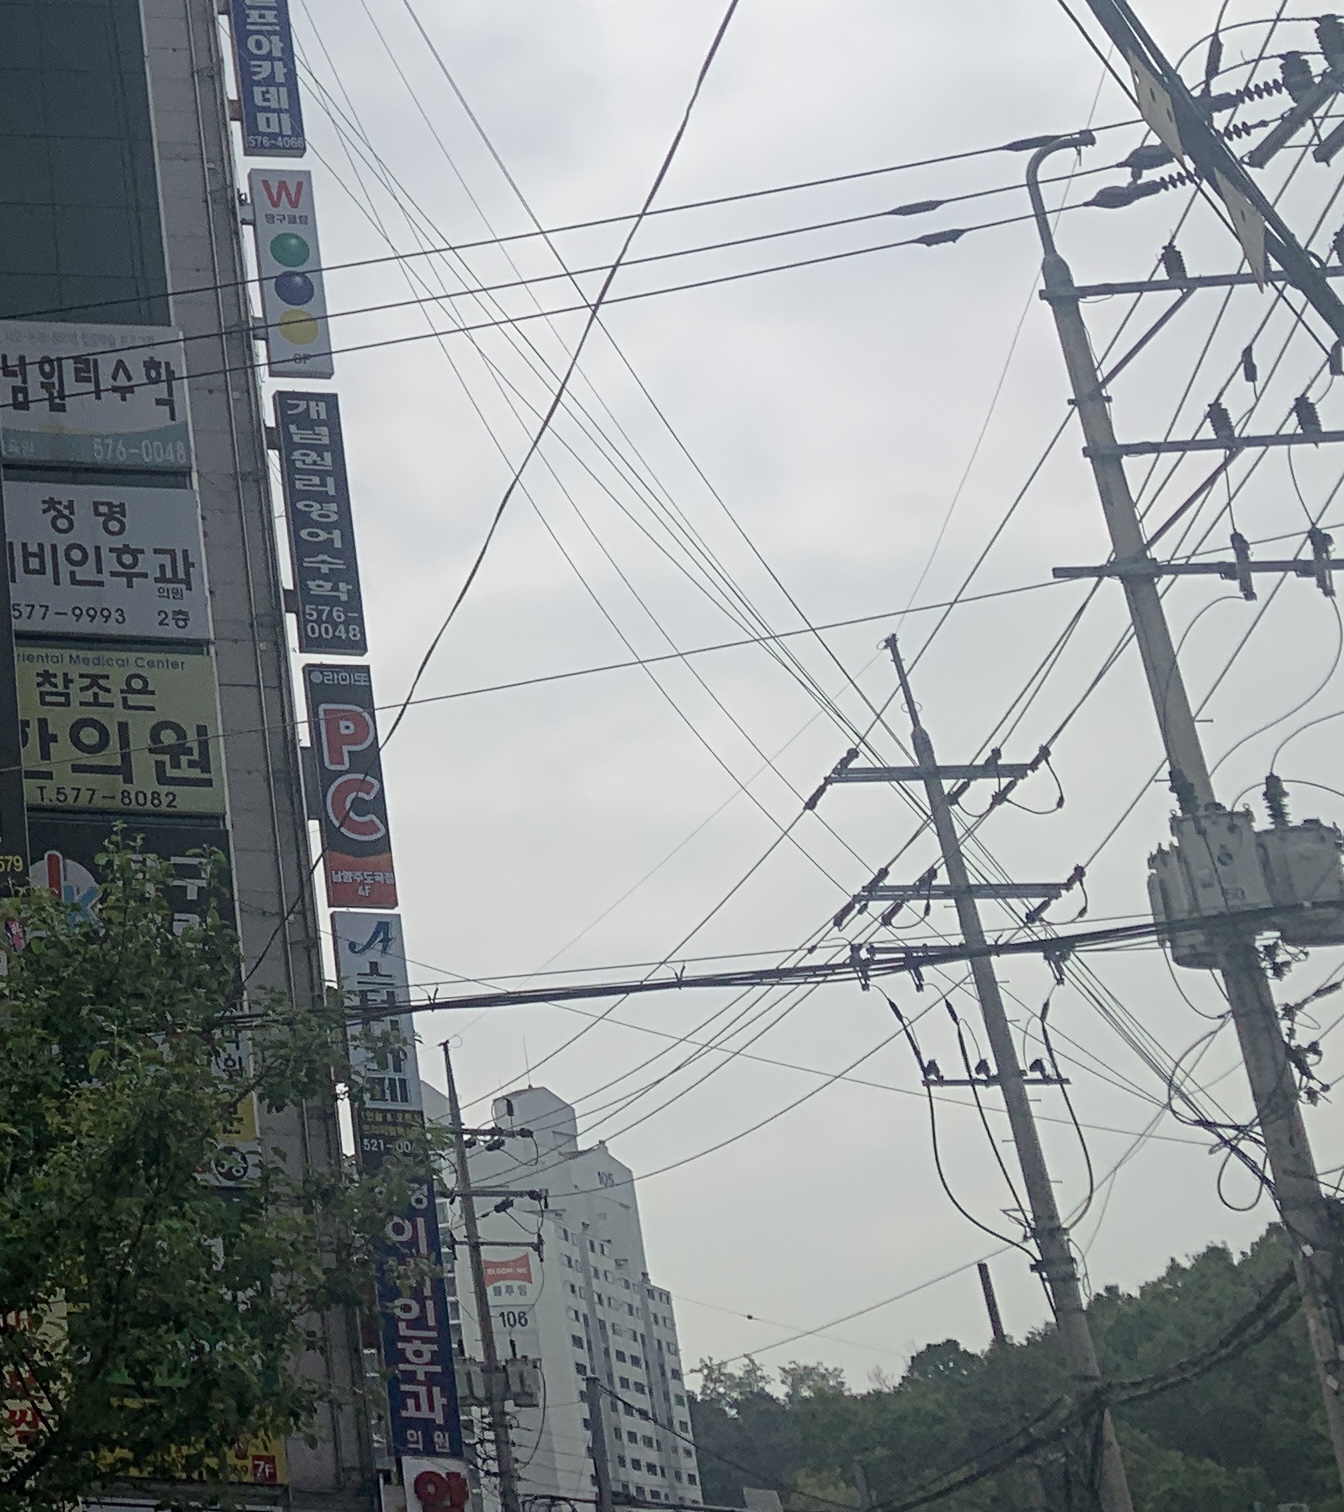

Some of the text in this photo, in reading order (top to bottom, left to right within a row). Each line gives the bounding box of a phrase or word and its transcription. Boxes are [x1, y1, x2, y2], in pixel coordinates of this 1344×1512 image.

[40, 496, 128, 537] 청명
[9, 541, 196, 591] 비인후과
[157, 609, 191, 630] 2층
[135, 655, 186, 671] Center
[35, 668, 157, 713] 참조은
[318, 703, 387, 841] PC
[499, 1311, 528, 1328] 106
